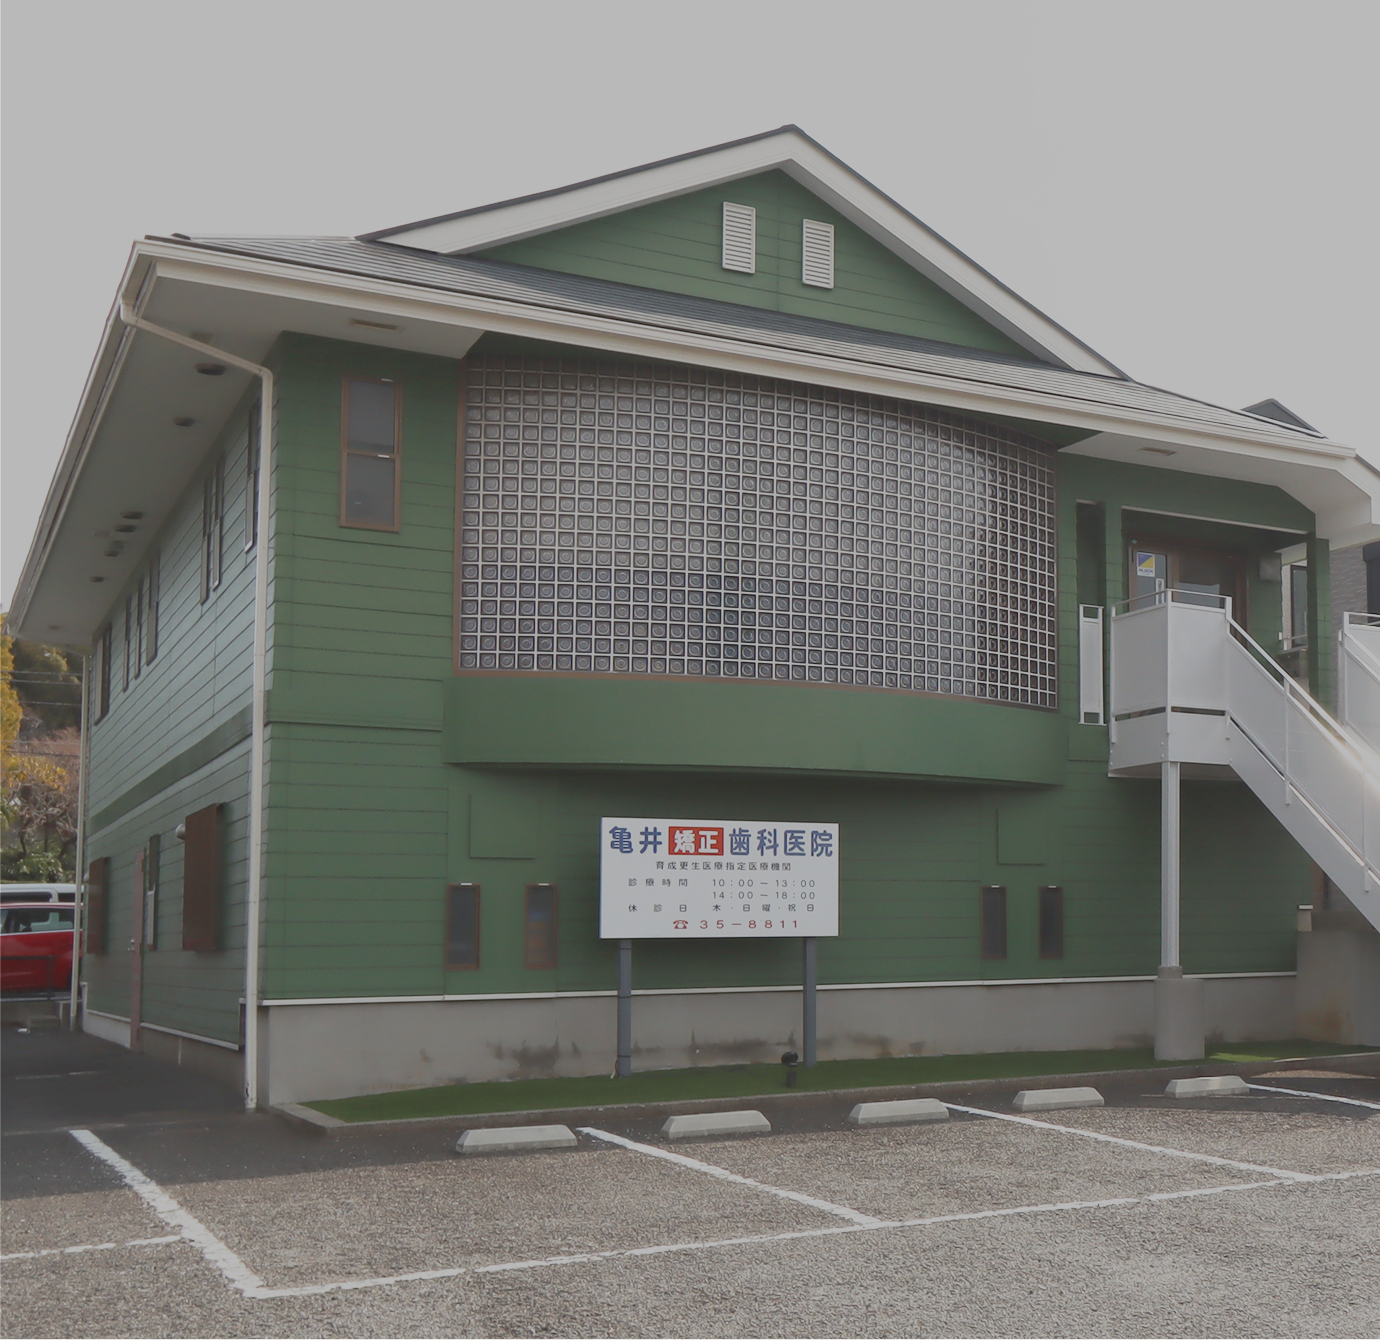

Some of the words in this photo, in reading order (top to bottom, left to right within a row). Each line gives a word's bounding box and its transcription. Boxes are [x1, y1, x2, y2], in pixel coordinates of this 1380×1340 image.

[609, 826, 833, 857] 亀井矯正歯科医院
[655, 861, 792, 871] 育成更生医療指定医療機関
[628, 878, 688, 887] 診療時間
[628, 904, 688, 913] 休診日
